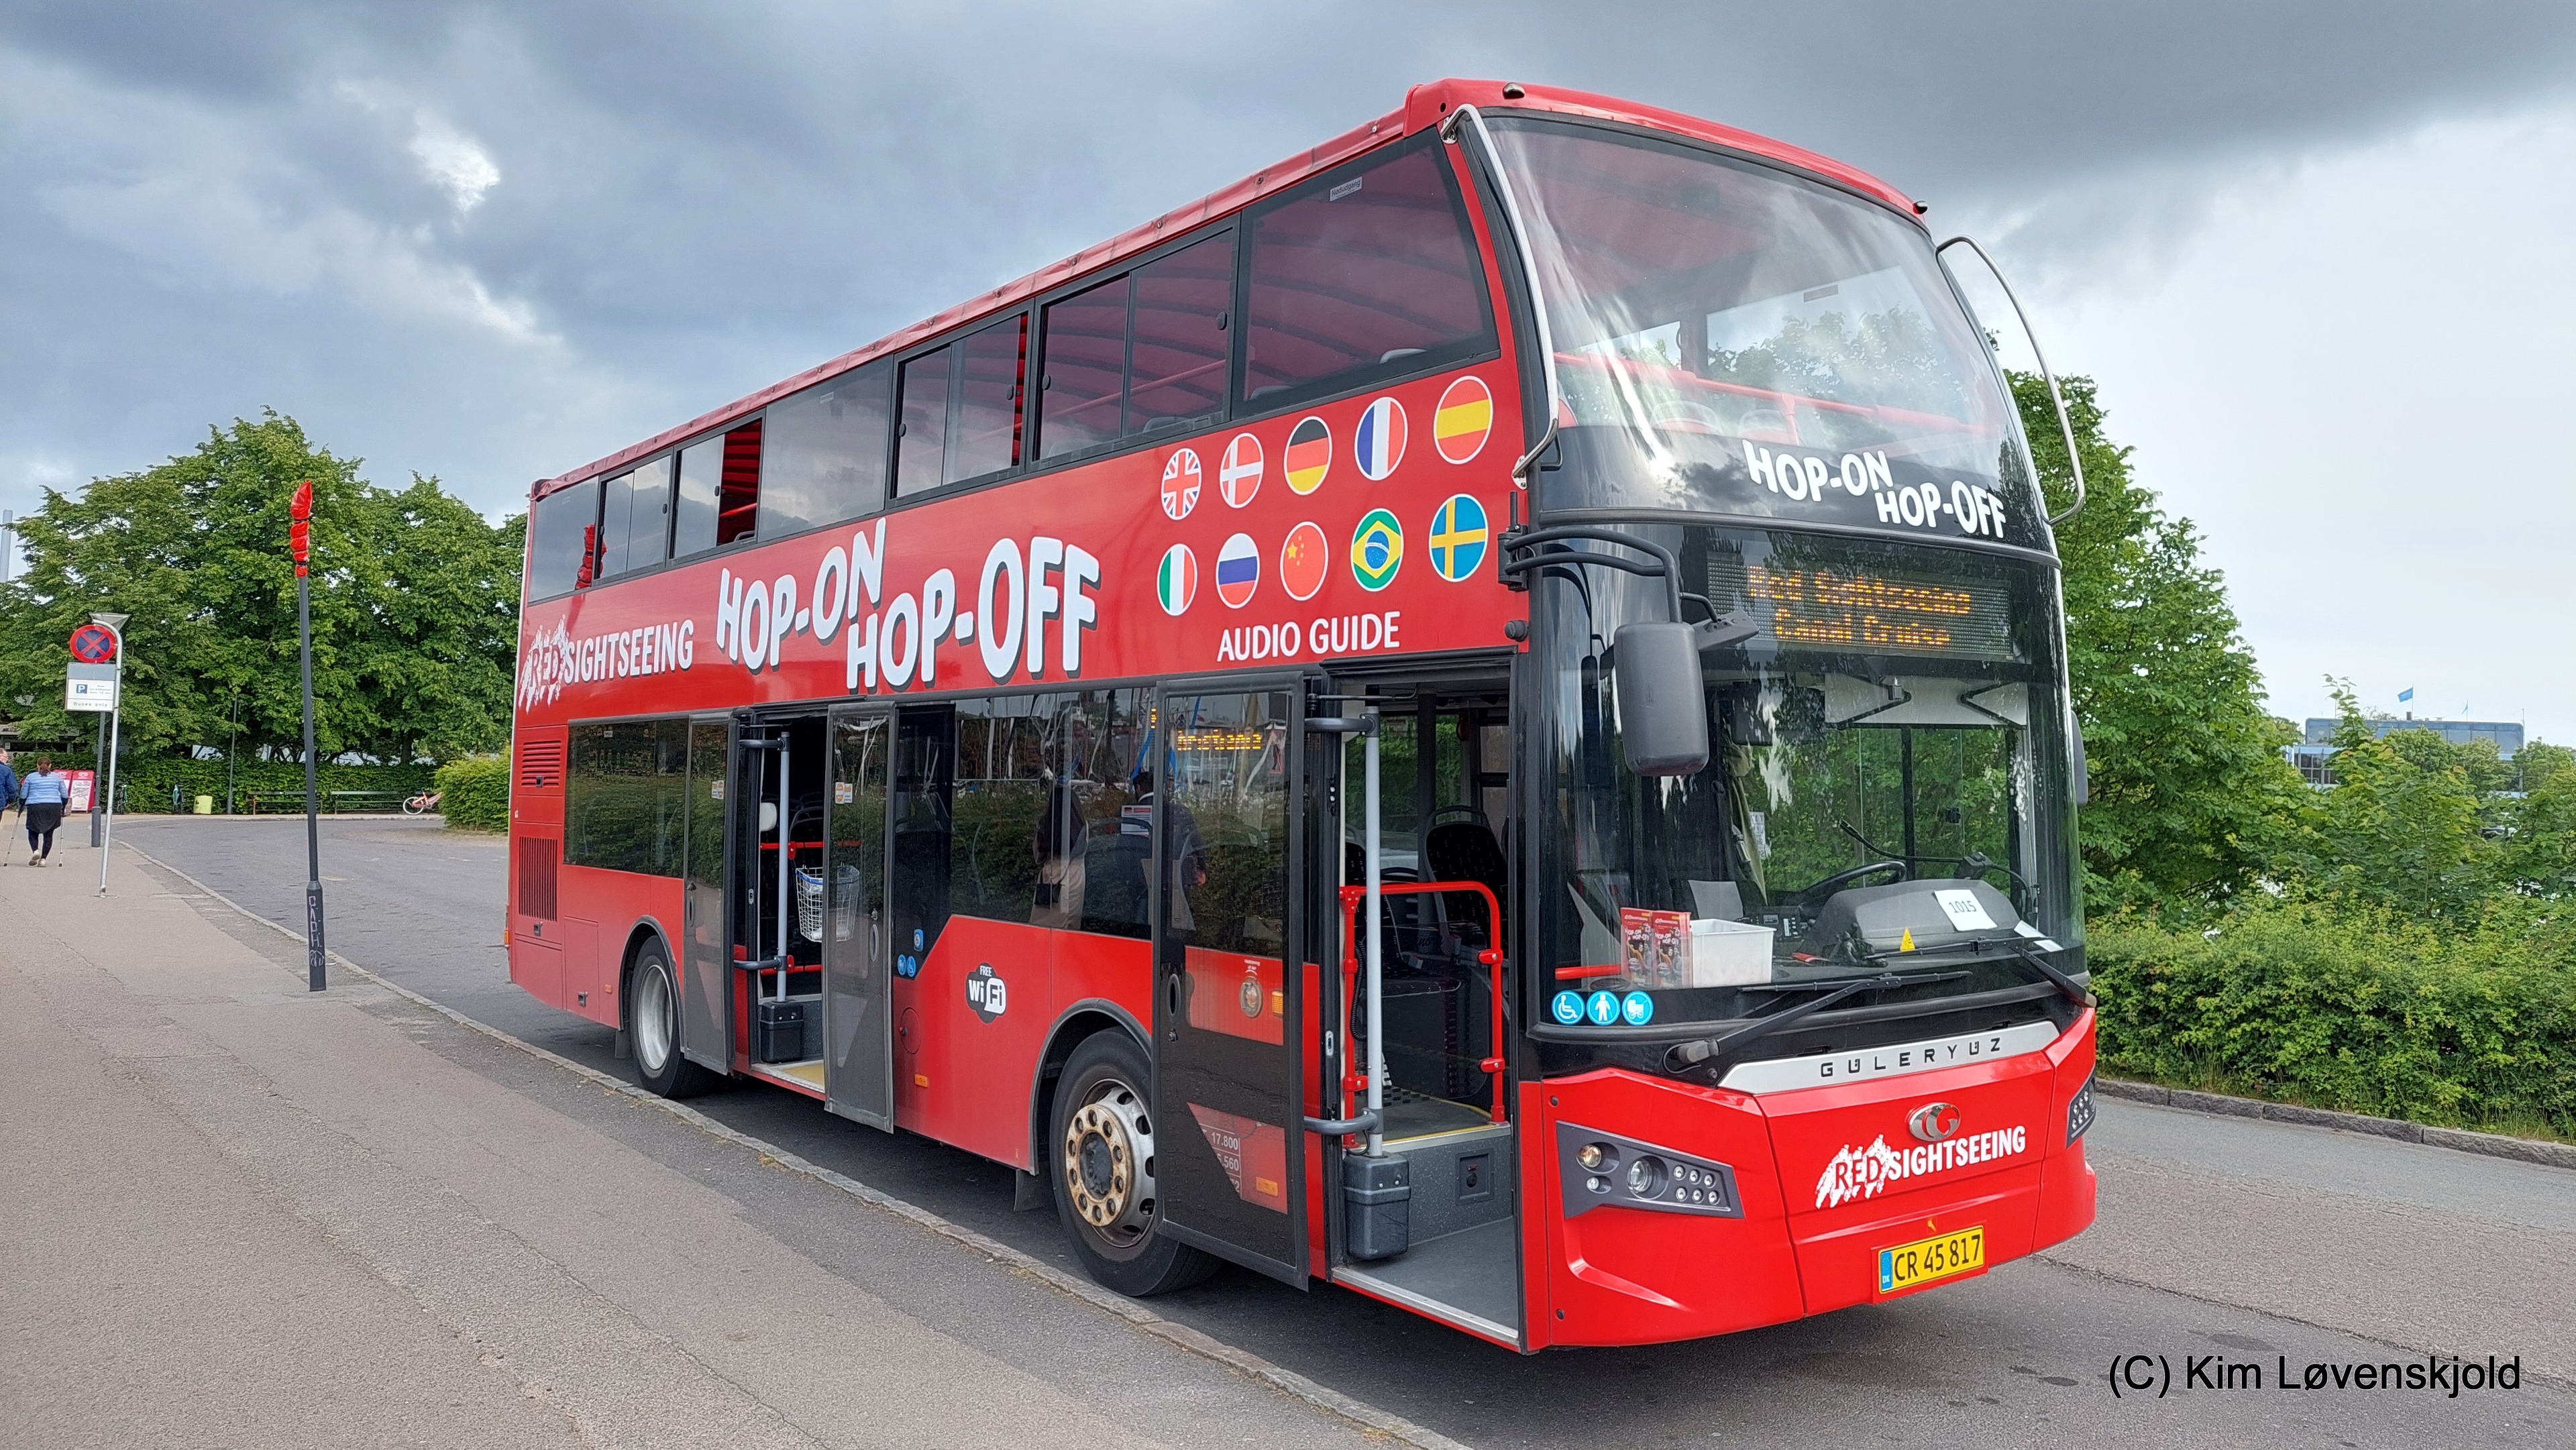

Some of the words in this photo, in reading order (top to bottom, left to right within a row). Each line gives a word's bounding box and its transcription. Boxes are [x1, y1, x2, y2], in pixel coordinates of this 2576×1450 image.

[1742, 439, 1894, 502] HOP-ON
[1875, 481, 2006, 539] HOP-OFF
[716, 517, 886, 670] HOP-ON
[847, 537, 1099, 689] HOP-OFF
[564, 619, 694, 685] SIGHTSEEING
[1216, 622, 1301, 662] AUDIO
[1309, 611, 1401, 654] GUIDE
[1948, 900, 1977, 913] 1015
[979, 965, 992, 977] FREE
[1212, 1131, 1238, 1150] 17.800
[1888, 1125, 2025, 1181] SIGHTSEEING
[1882, 1274, 1890, 1284] DK
[1894, 1251, 1919, 1282] CR
[1923, 1243, 1945, 1273] 45
[1949, 1234, 1981, 1268] 817
